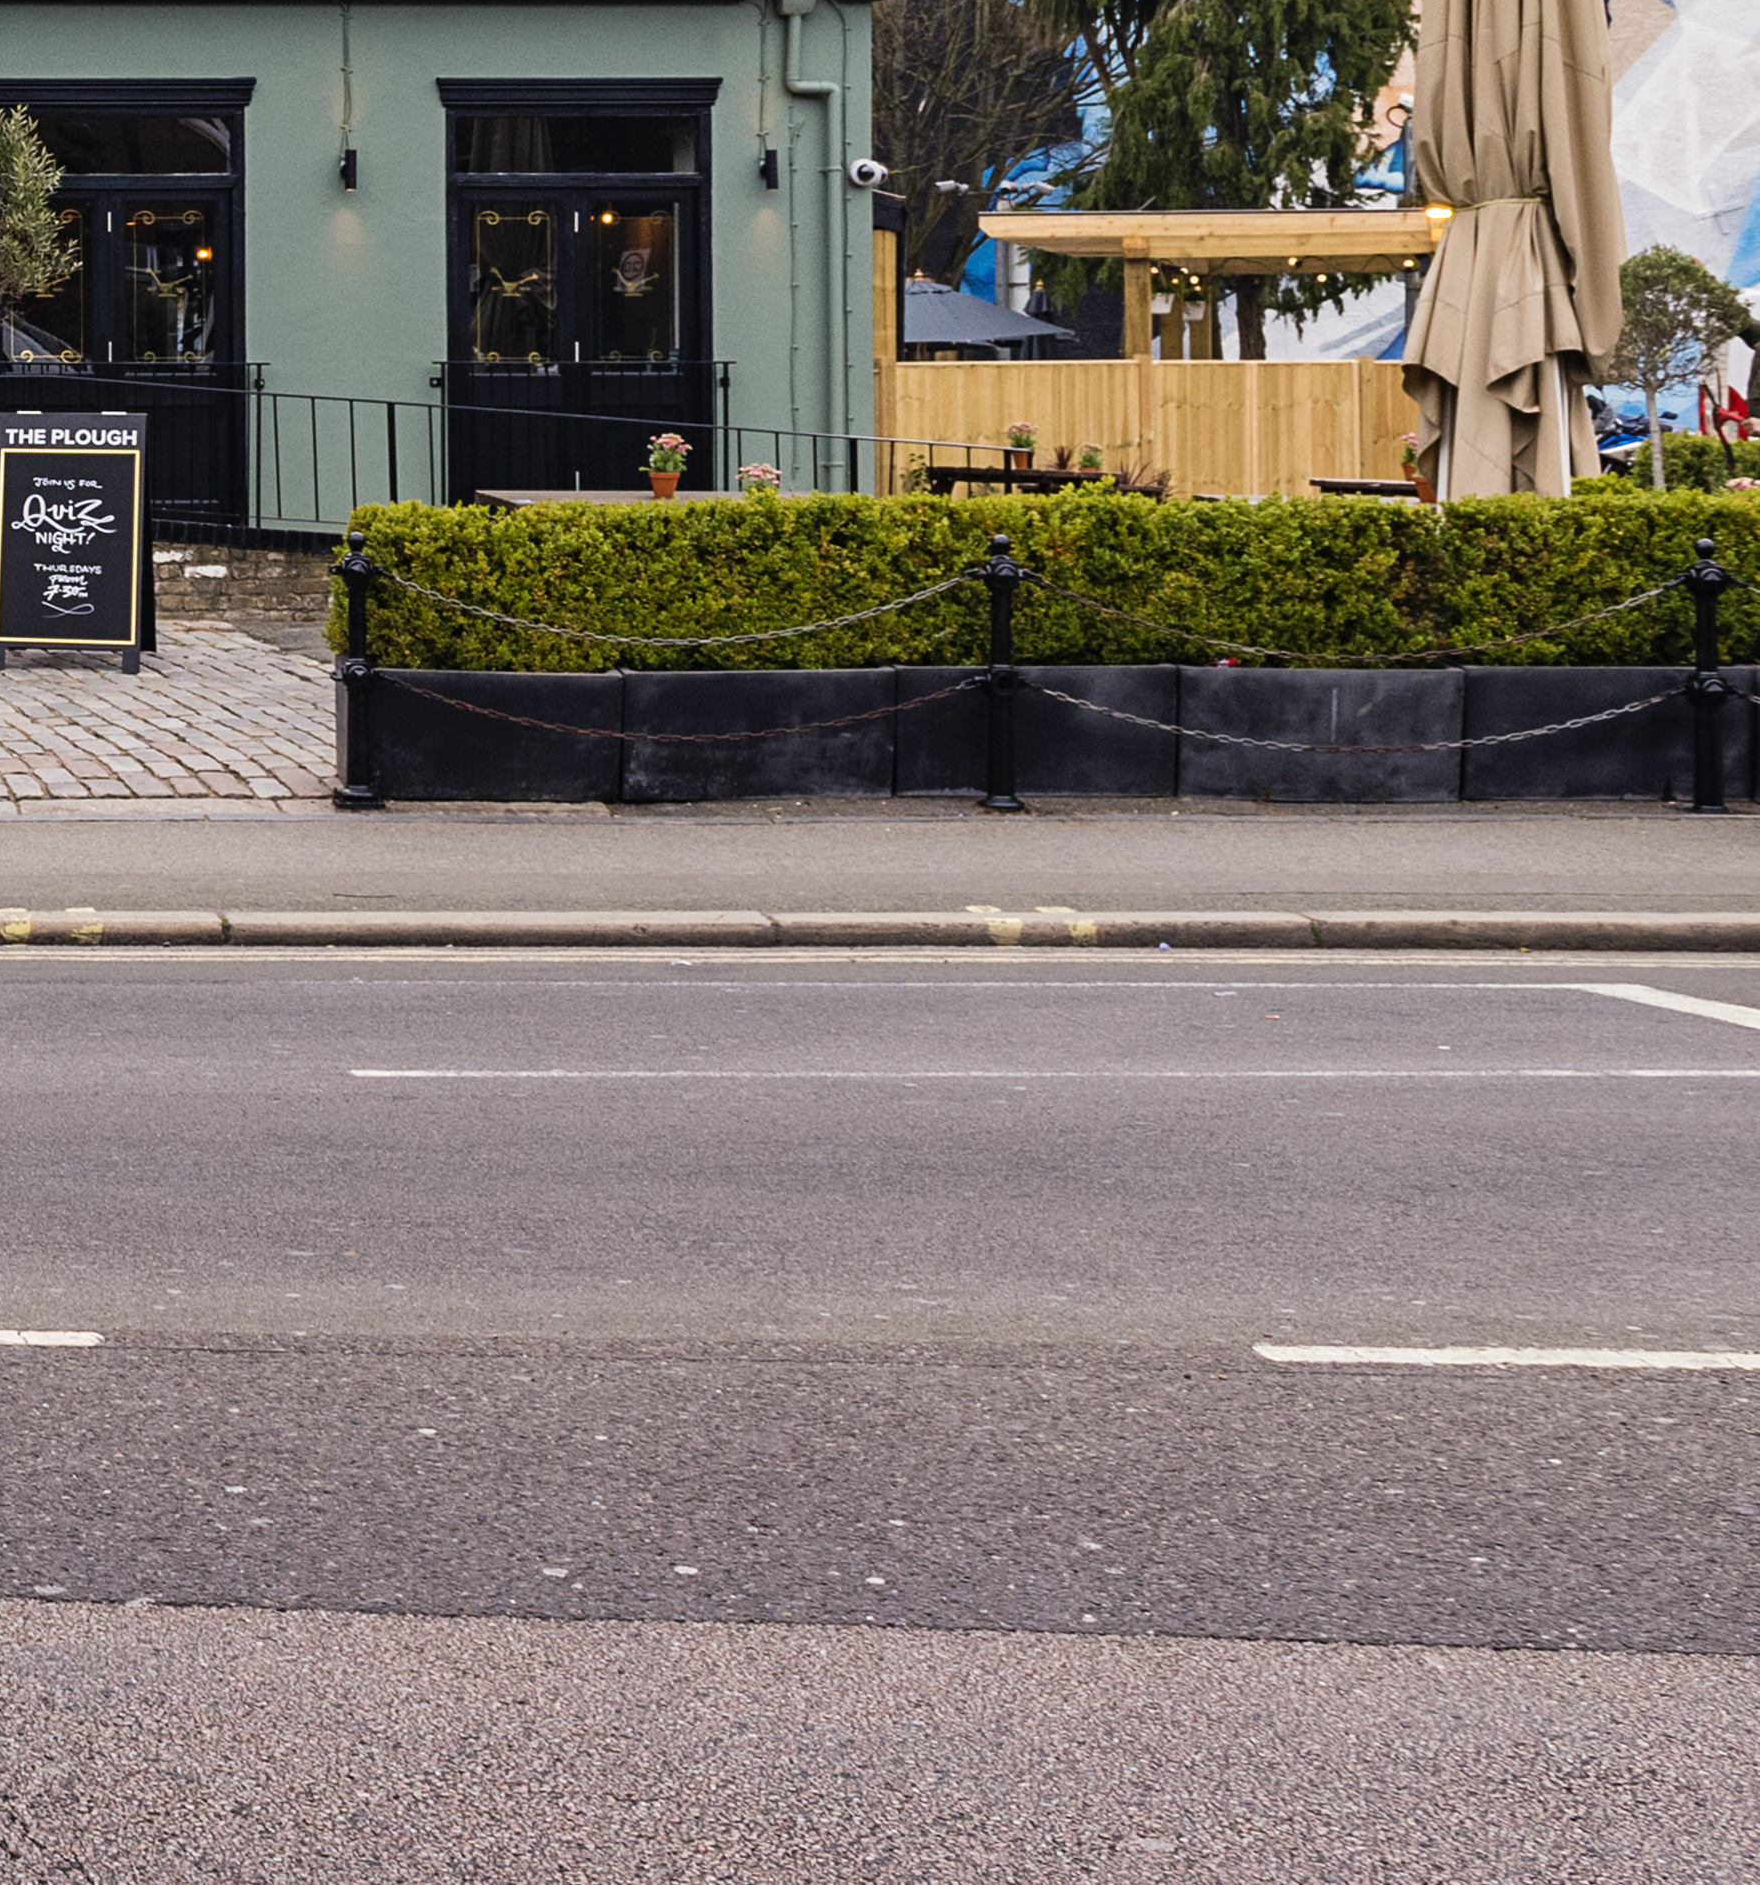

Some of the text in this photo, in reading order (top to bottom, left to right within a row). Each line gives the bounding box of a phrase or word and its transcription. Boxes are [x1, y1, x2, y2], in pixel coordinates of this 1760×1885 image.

[6, 428, 137, 446] THE PLOUGH
[79, 480, 103, 489] FOR
[35, 531, 96, 554] NIGHT!
[34, 564, 102, 574] THURSDAYS
